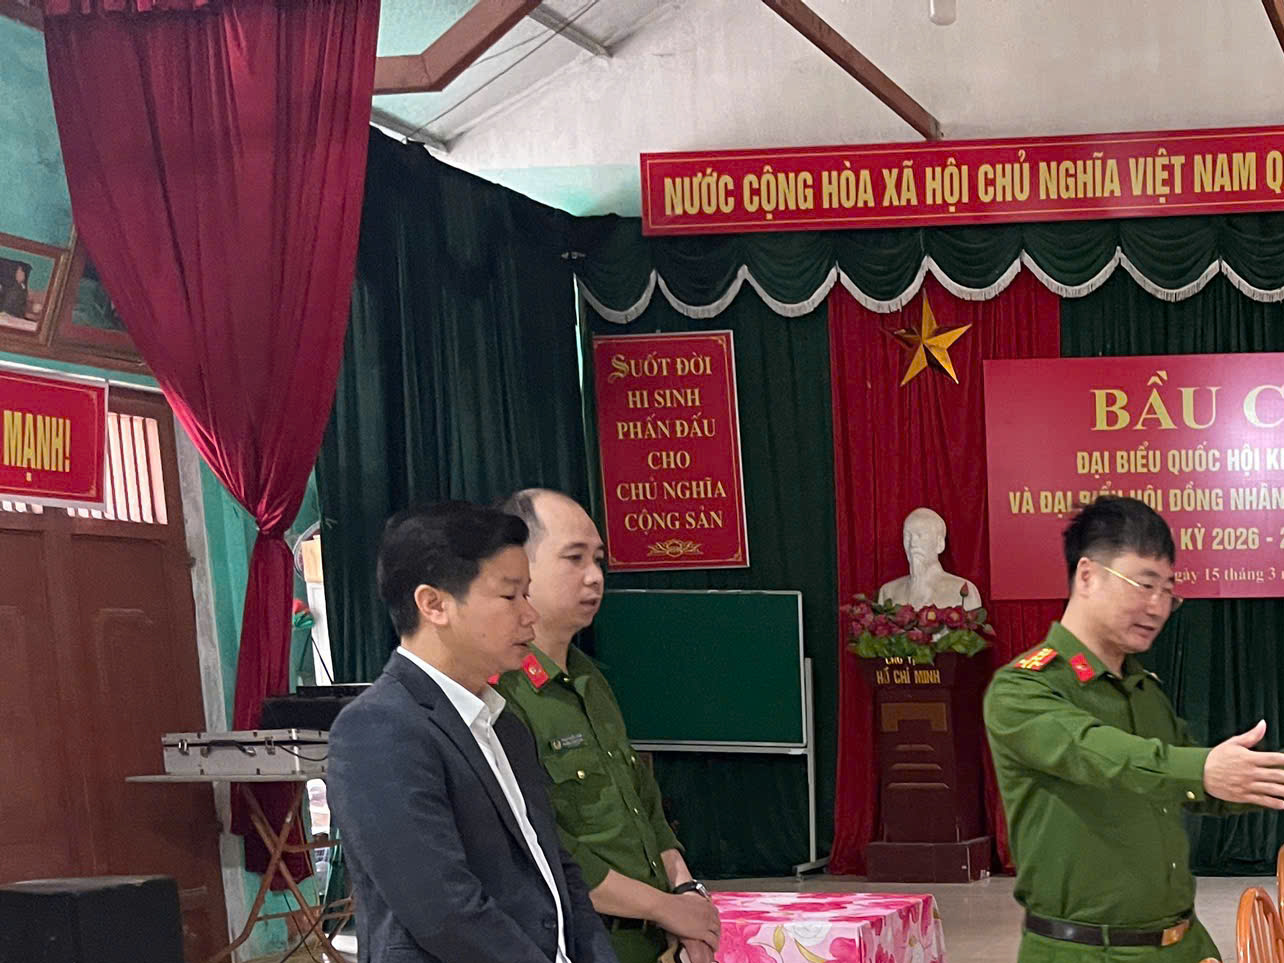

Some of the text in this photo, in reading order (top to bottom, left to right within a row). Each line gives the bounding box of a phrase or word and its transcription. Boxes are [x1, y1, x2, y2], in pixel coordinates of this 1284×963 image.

[664, 167, 734, 216] NƯỚC
[743, 166, 813, 220] CỘNG
[822, 161, 874, 208] HÒA
[882, 160, 914, 206] XÃ
[926, 157, 969, 213] HỘI
[978, 149, 1030, 202] CHỦ
[1039, 152, 1120, 200] NGHĨA
[1129, 148, 1185, 204] VIỆT
[1194, 152, 1256, 192] NAM
[608, 351, 712, 384] SUỐT ĐỜI
[627, 387, 701, 409] HI SINH
[1090, 370, 1221, 431] BẦU
[616, 412, 716, 440] PHẤN ĐẤU
[4, 409, 71, 482] MẠNH!
[648, 450, 691, 470] CHO
[1077, 450, 1110, 479] ĐẠI
[1116, 441, 1161, 473] BIỂU
[1168, 442, 1220, 476] QUỐC
[1227, 445, 1260, 475] HỘI
[616, 476, 727, 501] CHỦ NGHĨA
[1009, 487, 1034, 513] VÀ
[1040, 490, 1072, 519] ĐẠI
[1169, 479, 1223, 512] ĐỒNG
[1230, 482, 1284, 510] NHÂN
[625, 505, 723, 536] CỘNG SẢN
[1181, 523, 1205, 550] KỲ
[1212, 527, 1260, 550] 2026
[1173, 566, 1198, 585] gày
[1205, 567, 1220, 582] 15
[1224, 566, 1265, 585] tháng
[1268, 567, 1276, 580] 3
